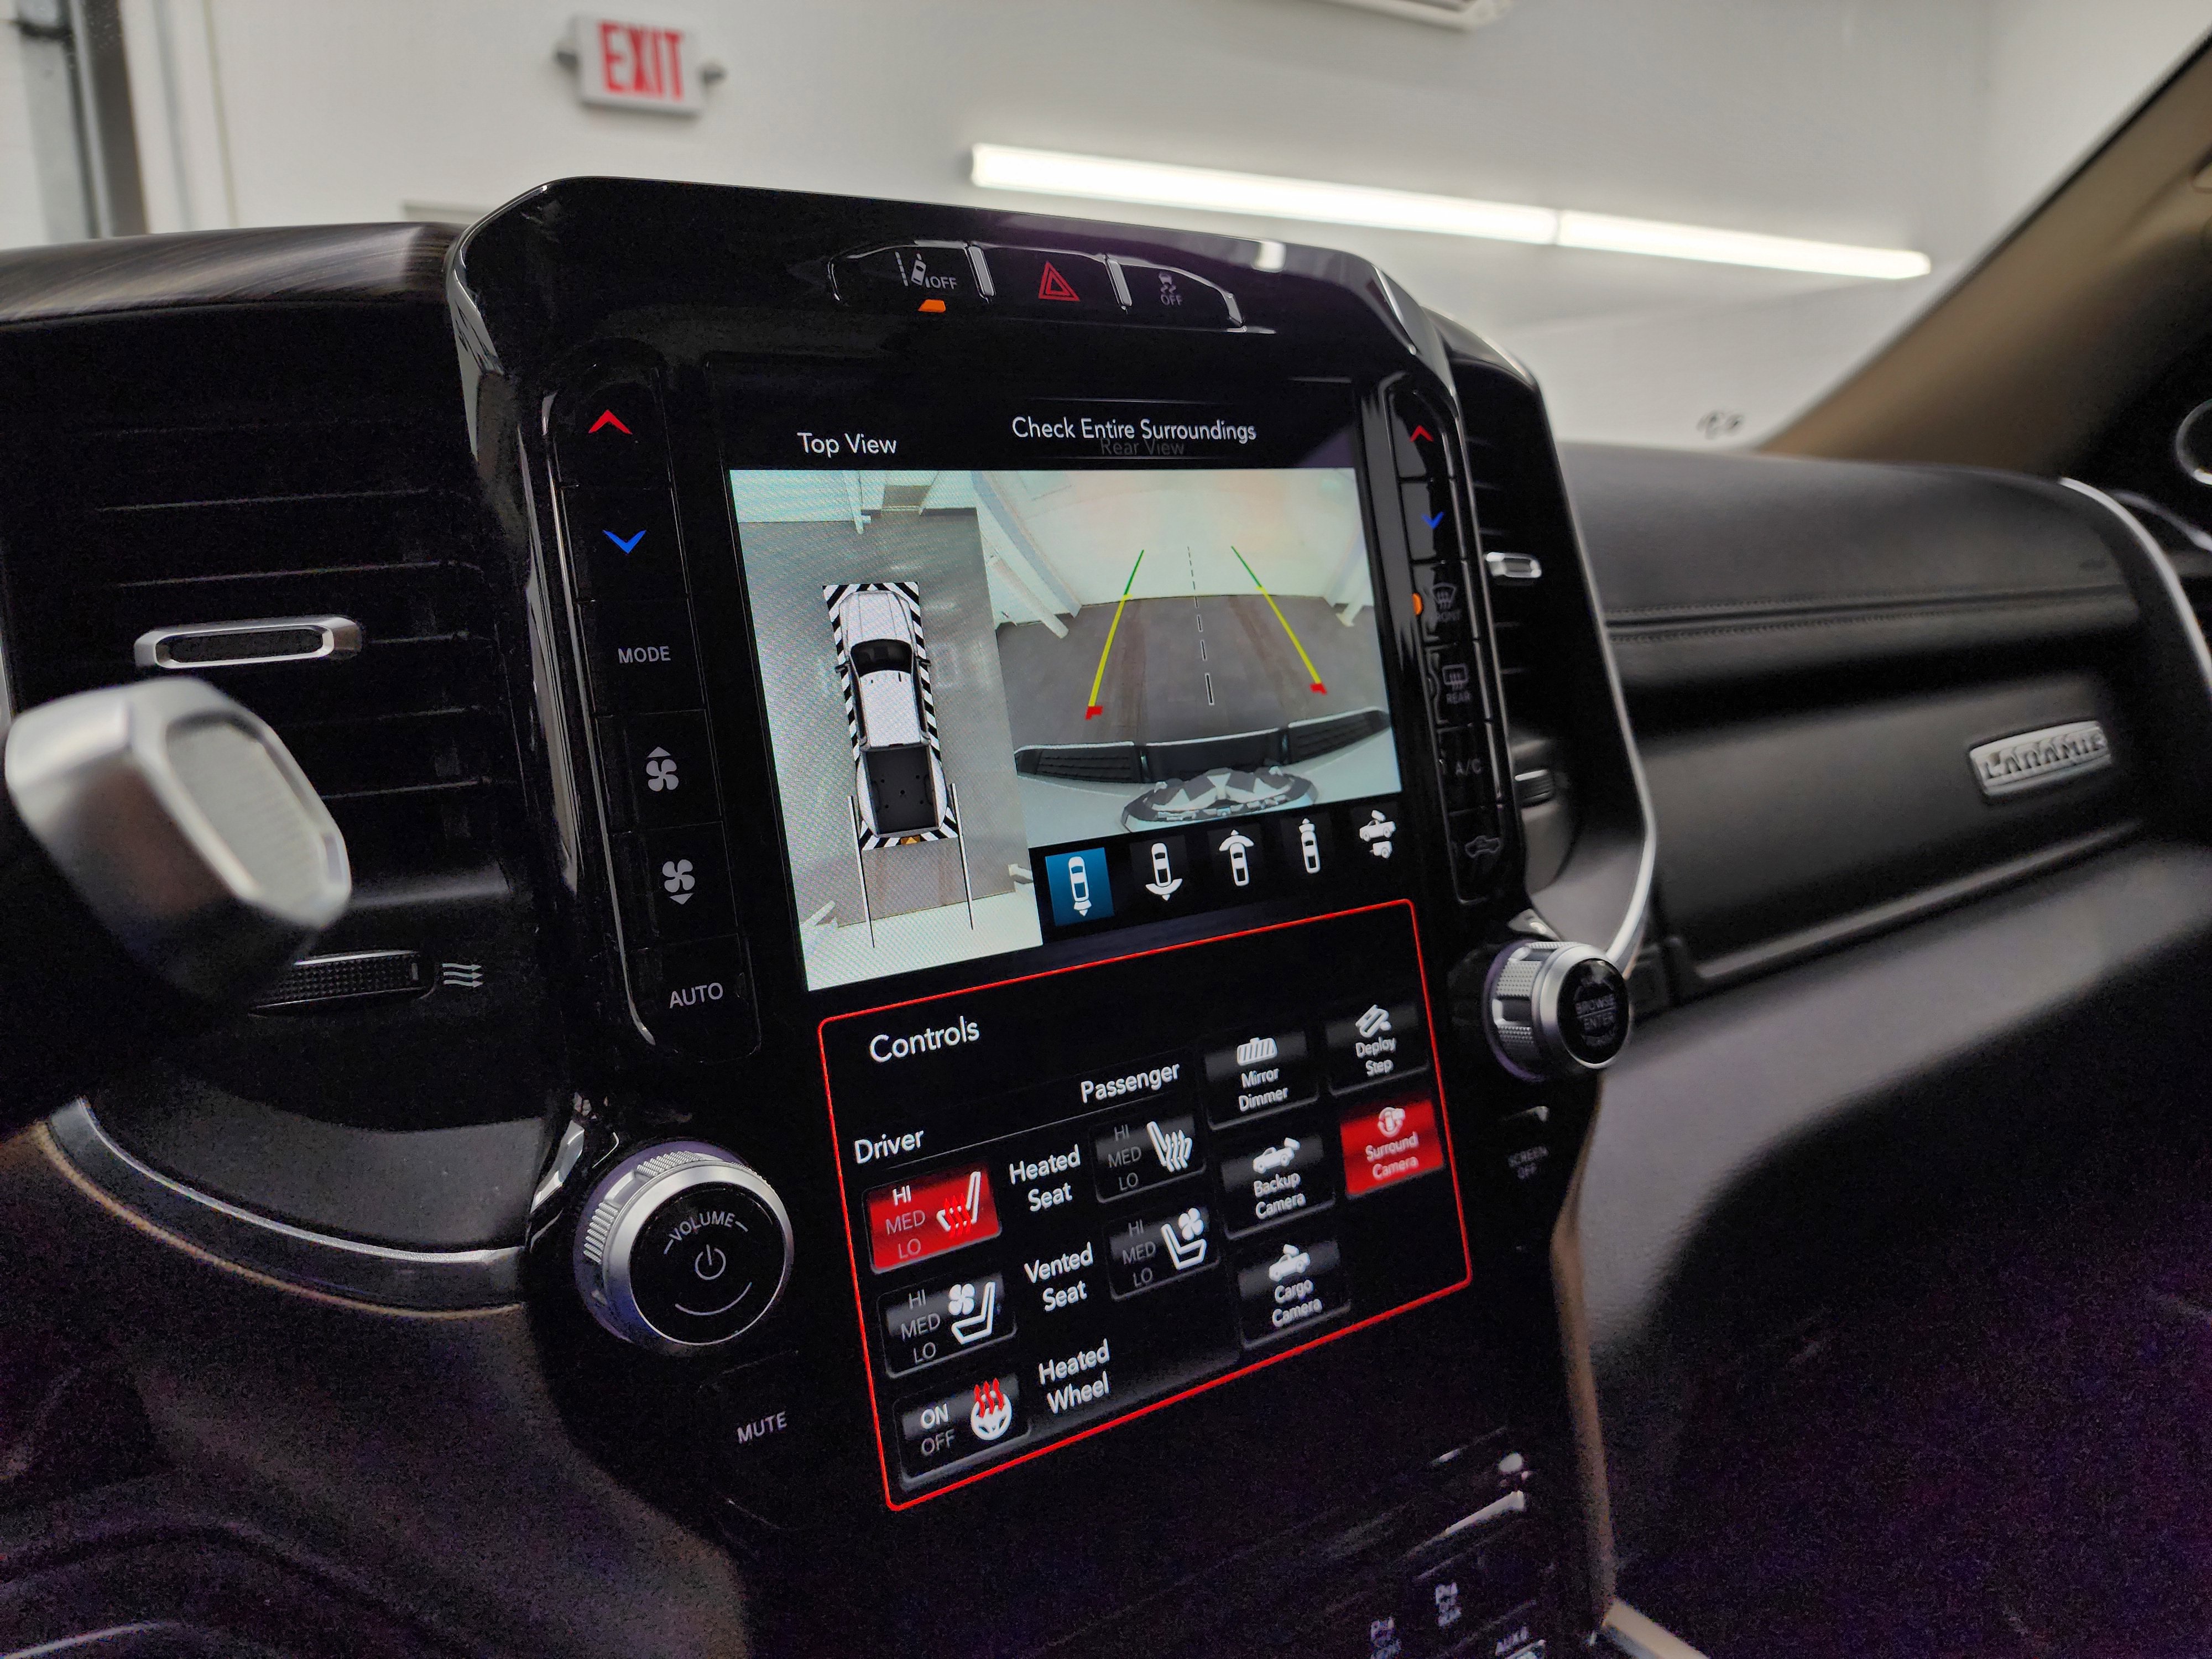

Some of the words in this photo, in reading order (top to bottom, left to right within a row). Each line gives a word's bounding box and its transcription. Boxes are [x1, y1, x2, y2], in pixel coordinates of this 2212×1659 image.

[598, 21, 684, 102] EXIT
[930, 276, 957, 289] OFF
[1161, 294, 1182, 306] OFF
[1012, 416, 1076, 438] Check
[1081, 418, 1135, 439] Entire
[1140, 418, 1256, 444] Surroundings
[796, 432, 839, 458] Top
[844, 432, 896, 454] View
[1100, 437, 1139, 455] Rear
[1144, 438, 1185, 455] View
[618, 646, 671, 663] MODE
[1455, 758, 1481, 775] A/C
[670, 982, 723, 1009] AUTO
[1583, 1011, 1616, 1031] ENTER
[869, 1016, 979, 1063] Controls
[1356, 1036, 1396, 1058] Deploy
[1241, 1067, 1279, 1088] Mirror
[1366, 1059, 1394, 1077] Step
[1081, 1063, 1180, 1103] Passenger
[1238, 1087, 1288, 1112] Dimmer
[1114, 1124, 1130, 1141] HI
[854, 1130, 924, 1164] Driver
[1108, 1146, 1141, 1168] MED
[1365, 1131, 1419, 1161] Surround
[1009, 1144, 1081, 1185] Heated
[1373, 1156, 1419, 1180] Camera
[1119, 1172, 1139, 1191] LO
[1254, 1173, 1301, 1198] Backup
[893, 1185, 911, 1206] HI
[1027, 1182, 1073, 1212] Seat
[1255, 1193, 1306, 1220] Camera
[669, 1211, 735, 1242] VOLUME
[886, 1210, 926, 1235] MED
[1128, 1219, 1145, 1238] HI
[898, 1238, 921, 1259] LO
[1123, 1241, 1156, 1265] MED
[1024, 1241, 1093, 1283] Vented
[1133, 1267, 1154, 1287] LO
[908, 1289, 926, 1310] HI
[1042, 1280, 1087, 1312] Seat
[1275, 1279, 1314, 1304] Cargo
[1272, 1298, 1323, 1328] Camera
[901, 1313, 941, 1342] MED
[914, 1342, 936, 1364] LO
[1038, 1338, 1110, 1385] Heated
[1047, 1371, 1109, 1414] Wheel
[737, 1412, 787, 1444] MUTE
[920, 1403, 949, 1430] ON
[921, 1428, 955, 1456] OFF
